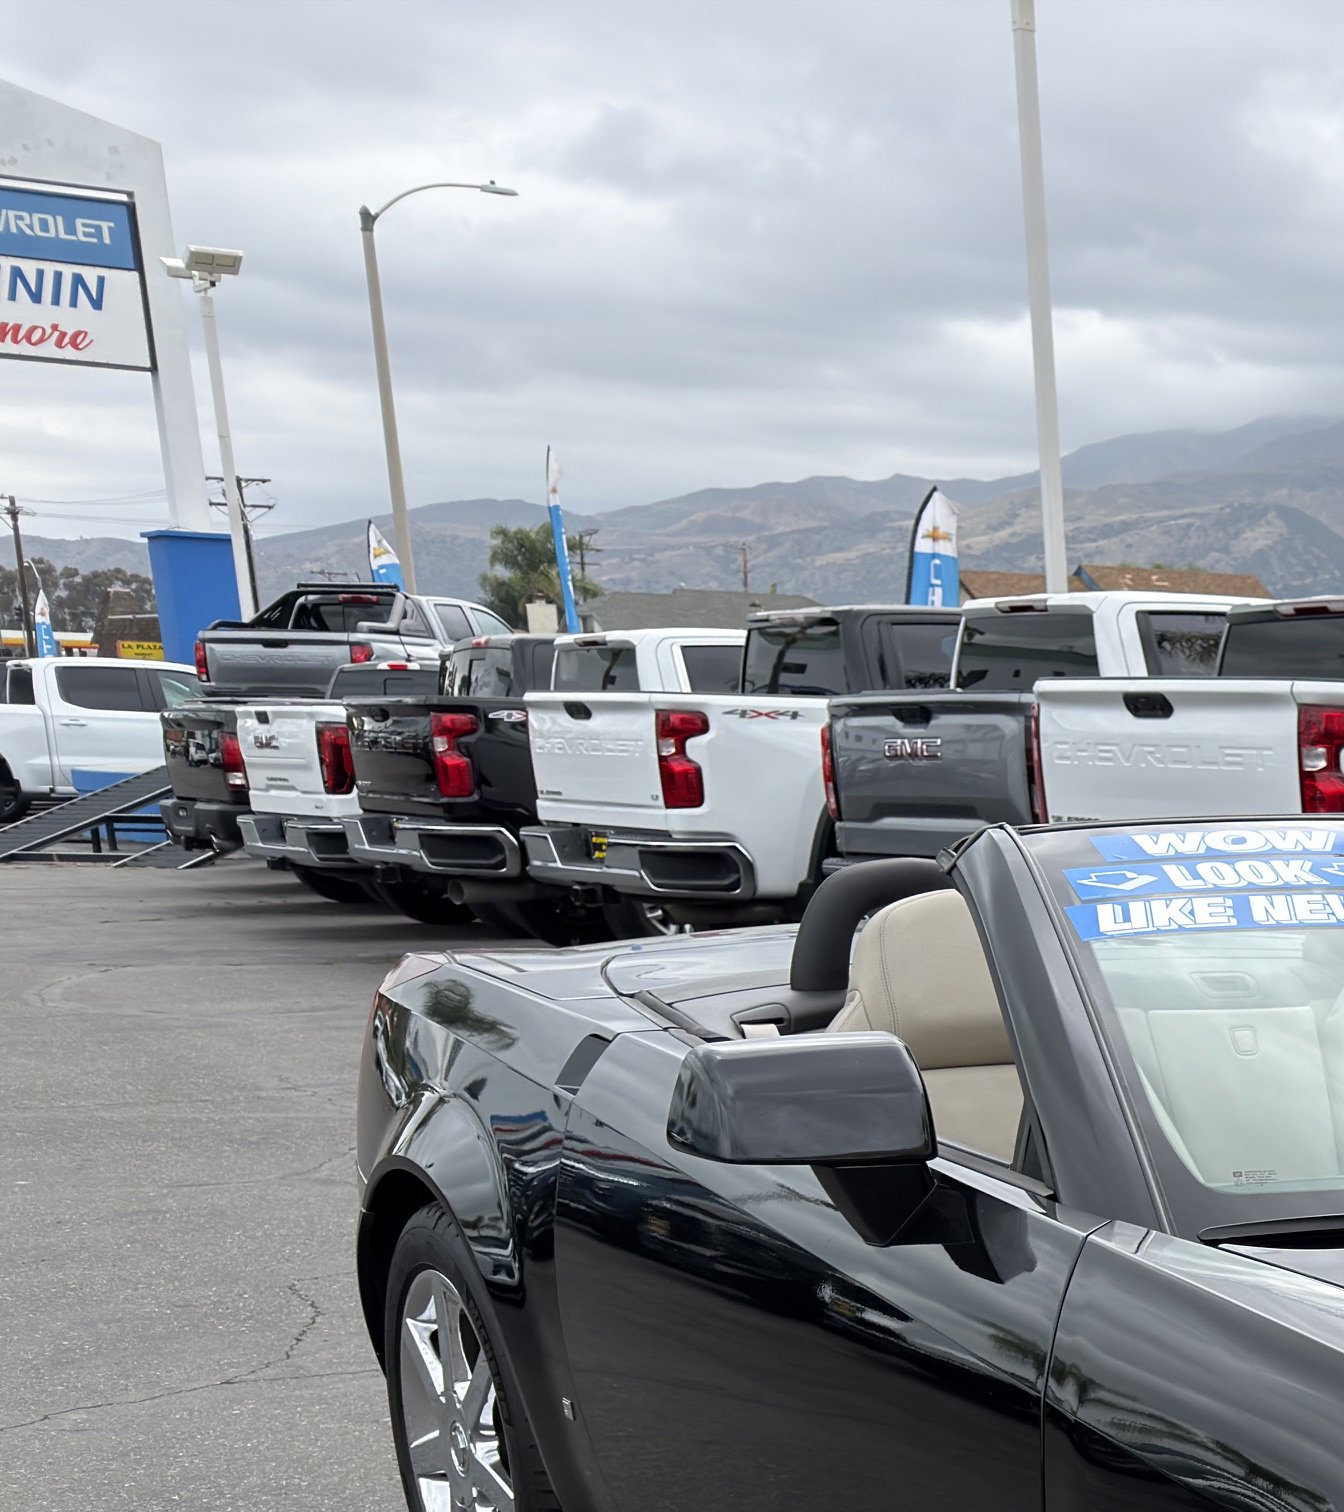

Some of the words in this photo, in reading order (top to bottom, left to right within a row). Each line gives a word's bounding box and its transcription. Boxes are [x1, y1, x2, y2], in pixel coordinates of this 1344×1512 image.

[722, 709, 804, 721] 4X4
[883, 738, 942, 761] GMC
[1052, 741, 1275, 772] CHEVROLET
[1160, 858, 1331, 890] LOOK
[1096, 896, 1238, 935] LIKE
